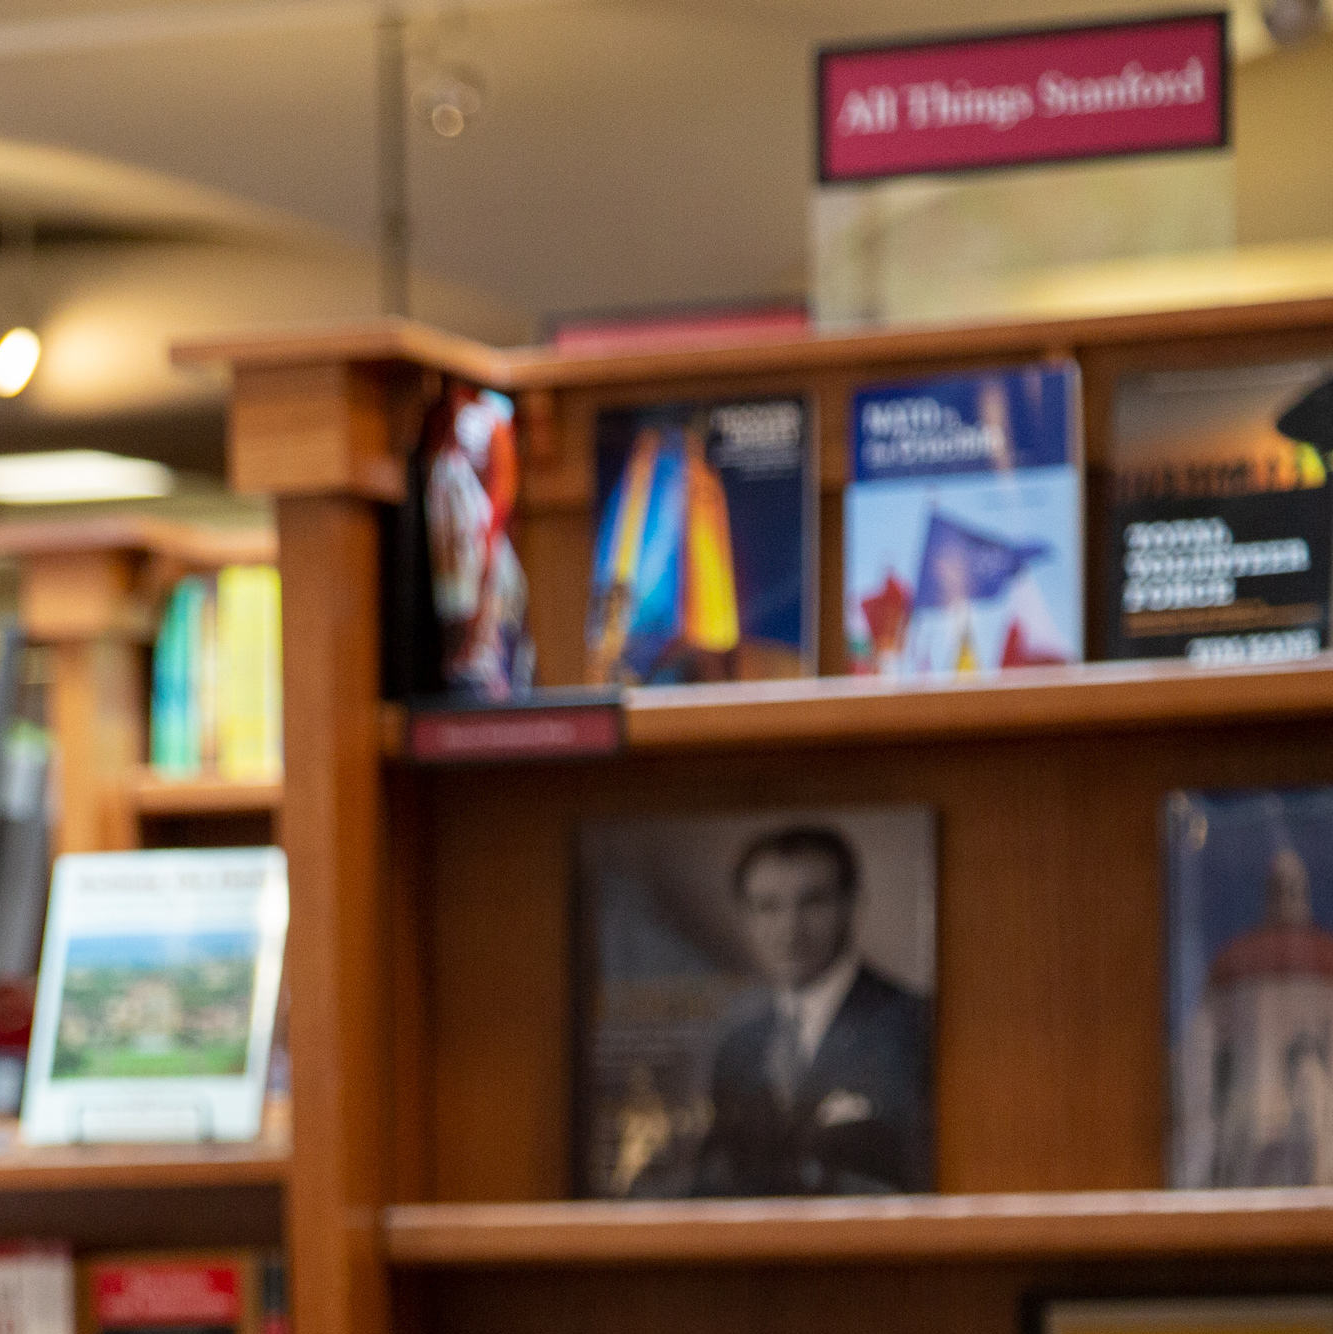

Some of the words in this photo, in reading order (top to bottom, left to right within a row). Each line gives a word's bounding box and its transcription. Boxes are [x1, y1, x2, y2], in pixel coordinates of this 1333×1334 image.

[837, 85, 898, 137] All
[900, 79, 1032, 131] Things
[1037, 55, 1205, 119] Stanford
